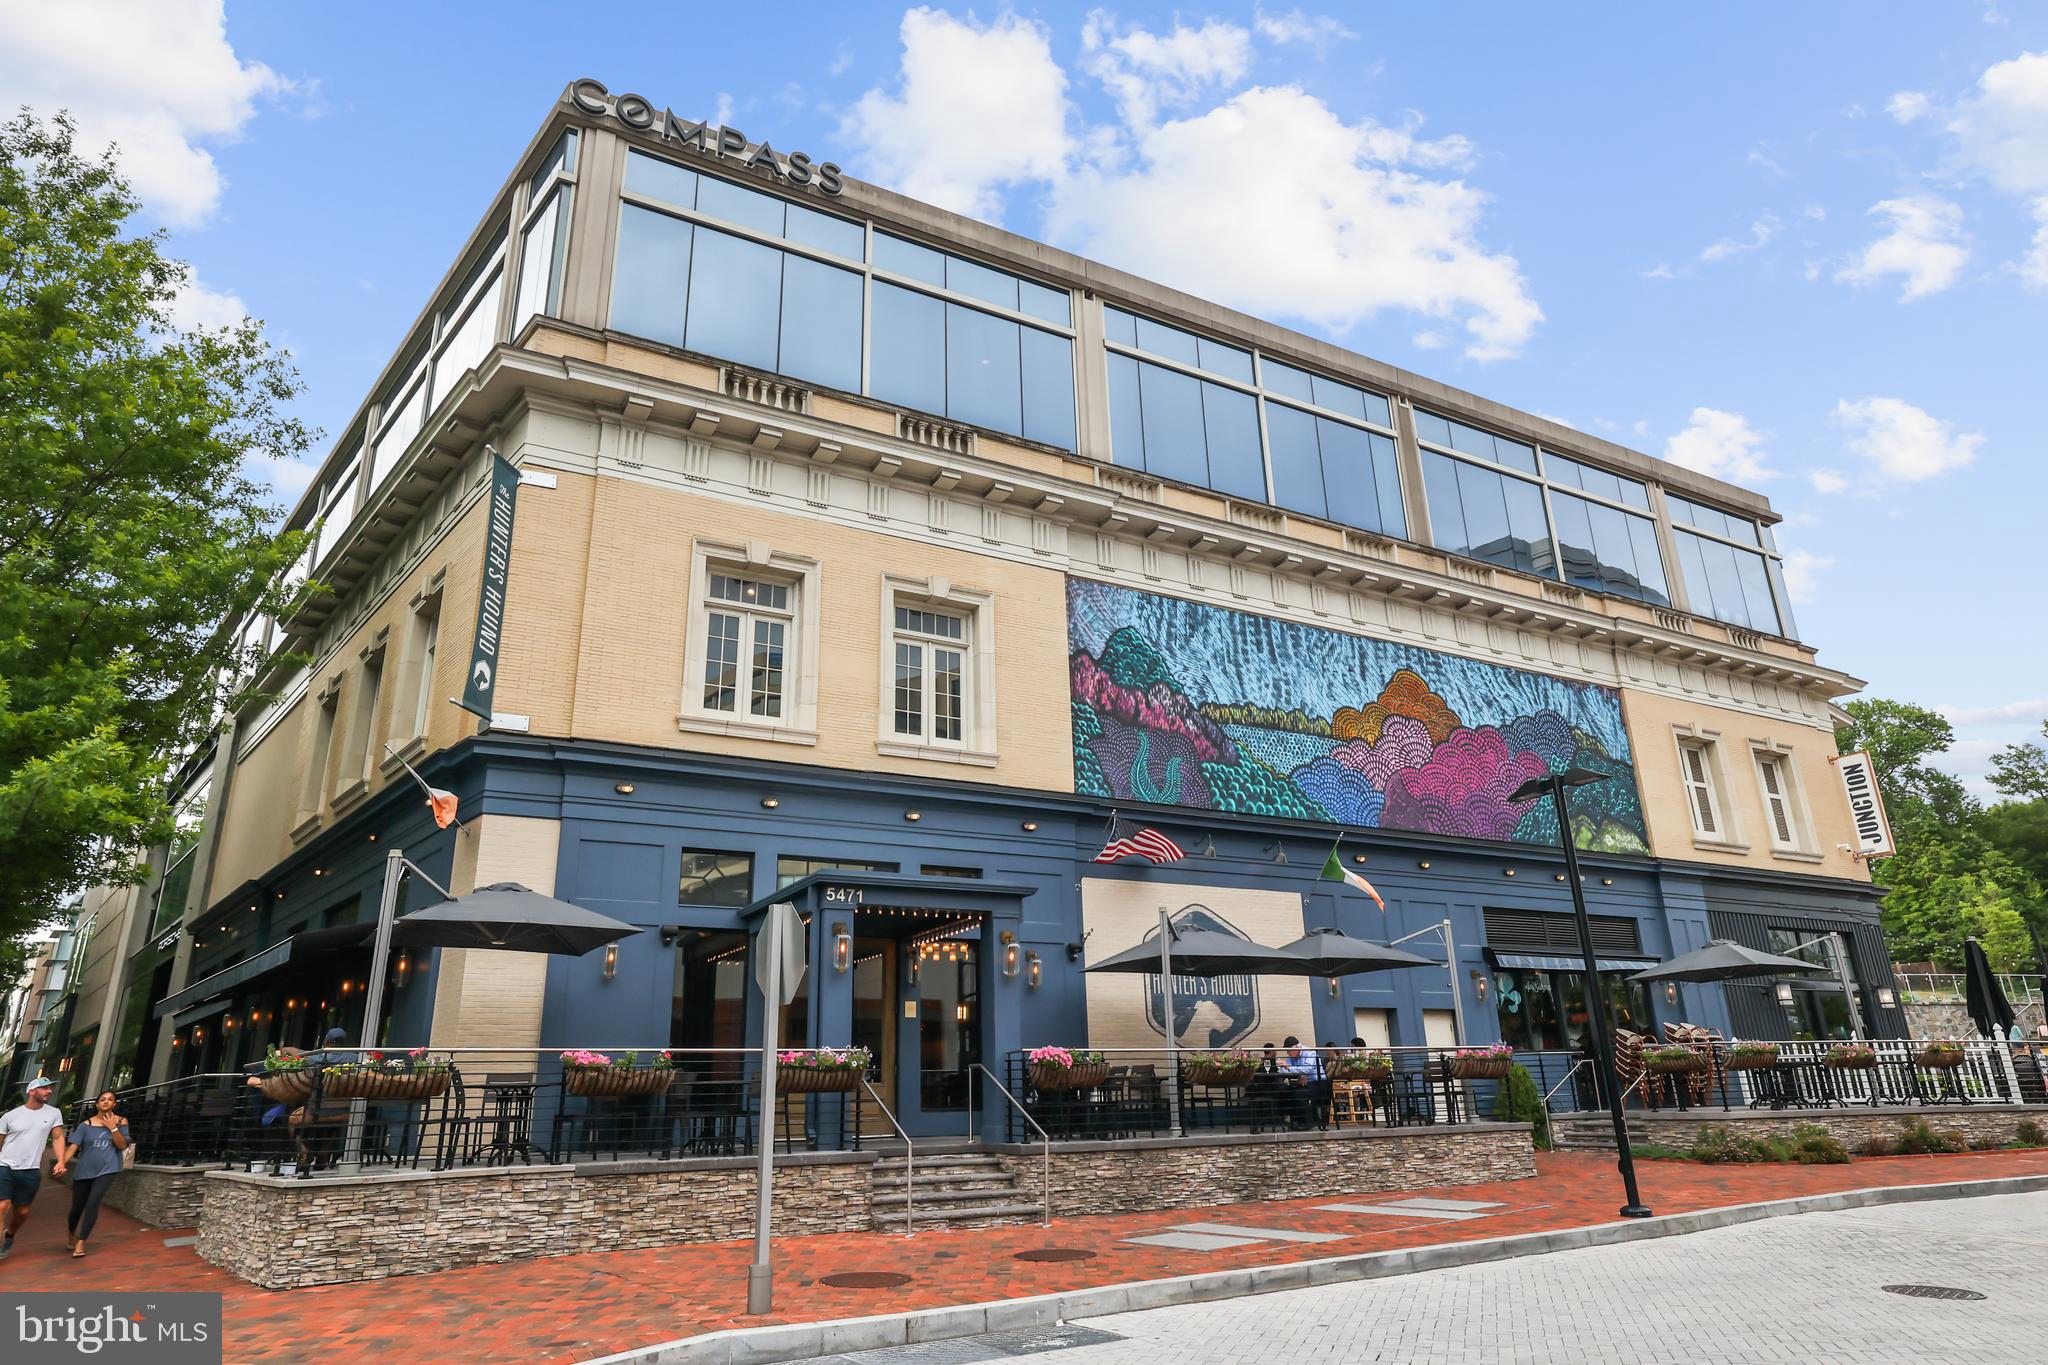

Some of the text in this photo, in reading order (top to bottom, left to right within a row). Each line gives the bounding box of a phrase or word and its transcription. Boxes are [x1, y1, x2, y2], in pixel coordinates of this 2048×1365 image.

[571, 78, 843, 196] COMPASS
[479, 495, 511, 656] HUNTER'S HOUND
[1843, 763, 1882, 844] JUNCTION
[826, 887, 863, 903] 5471
